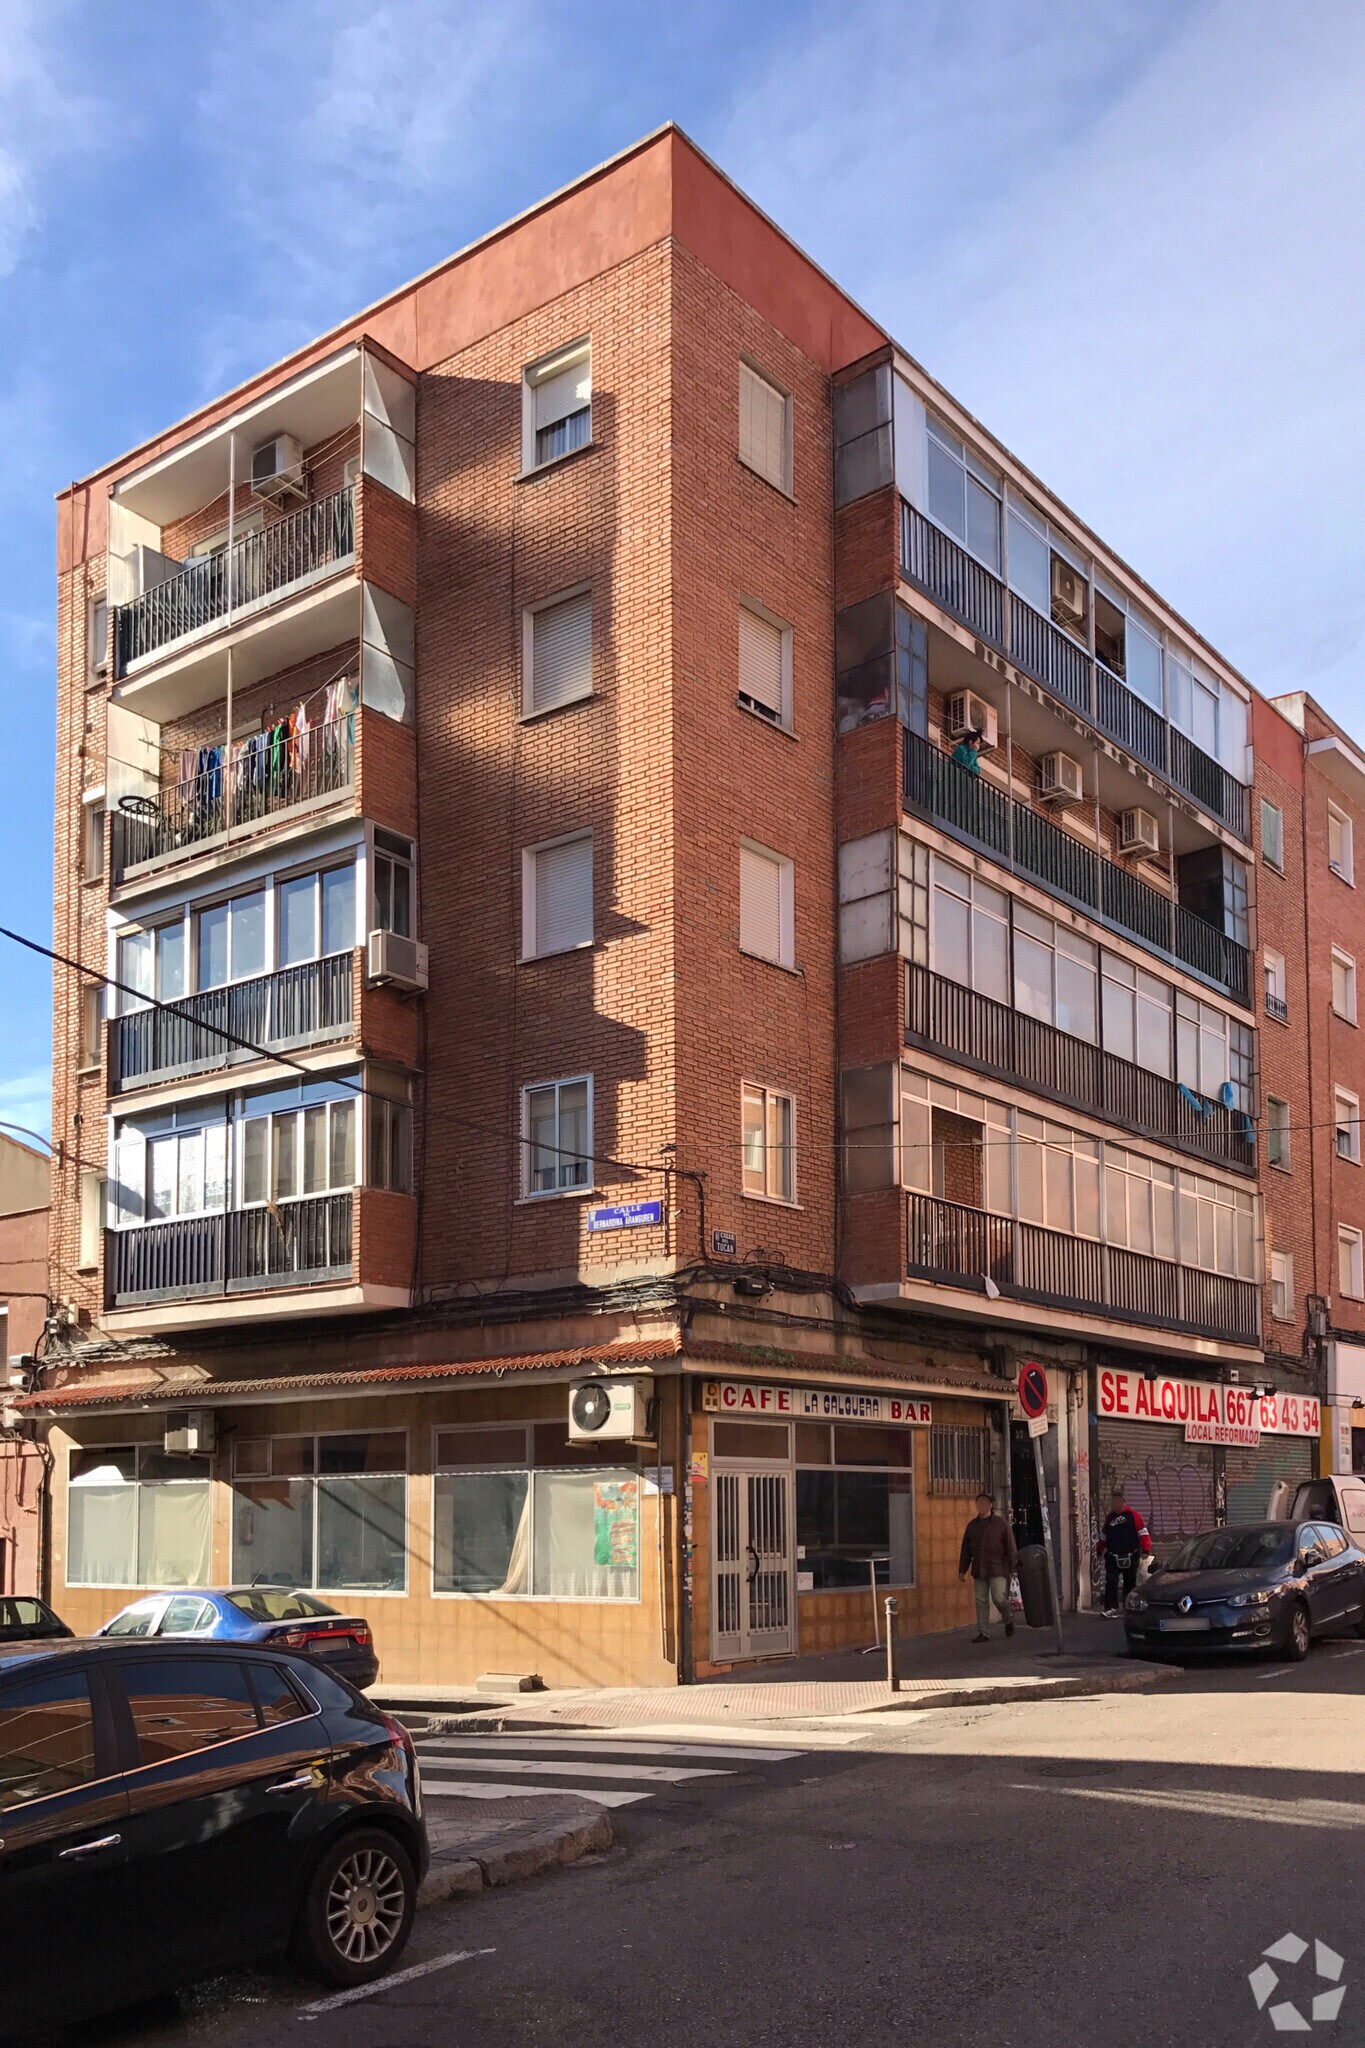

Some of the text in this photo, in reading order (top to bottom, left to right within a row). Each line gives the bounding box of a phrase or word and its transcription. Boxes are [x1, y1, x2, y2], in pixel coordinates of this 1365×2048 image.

[613, 1205, 642, 1214] CALLE
[720, 1232, 735, 1240] CALLE
[723, 1386, 931, 1421] CAFE LA GALGUERA BAR
[1101, 1372, 1319, 1432] SE ALQUILA 667 63 43 54
[1186, 1424, 1259, 1444] LOCAL REFORMADO
